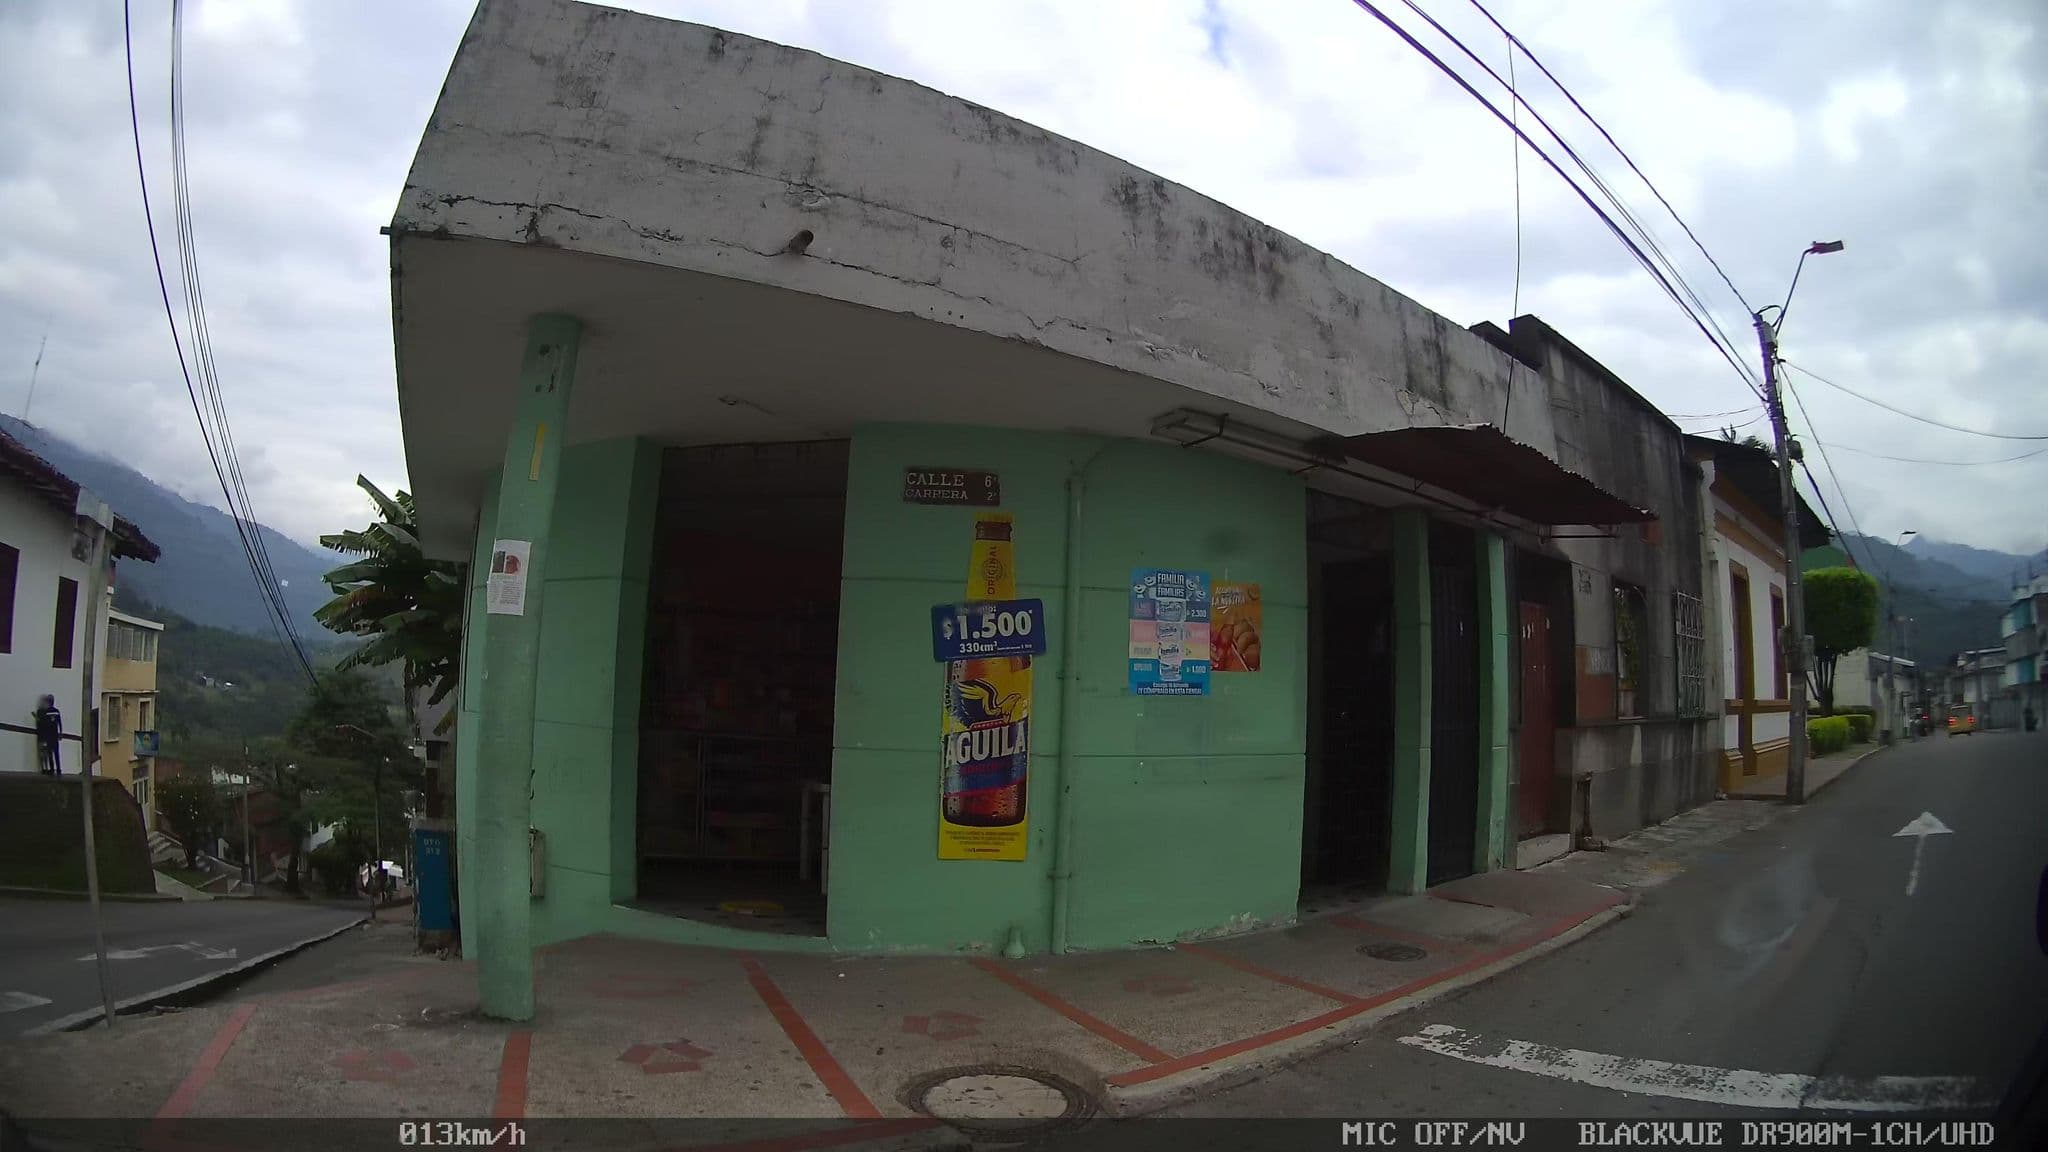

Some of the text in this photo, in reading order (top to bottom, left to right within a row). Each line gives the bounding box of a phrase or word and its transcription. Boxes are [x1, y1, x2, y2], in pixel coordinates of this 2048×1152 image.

[906, 472, 965, 487] CALLE
[987, 546, 998, 595] ORIGINAL
[1157, 573, 1185, 585] FAMILIA
[944, 721, 1026, 769] AGUILA
